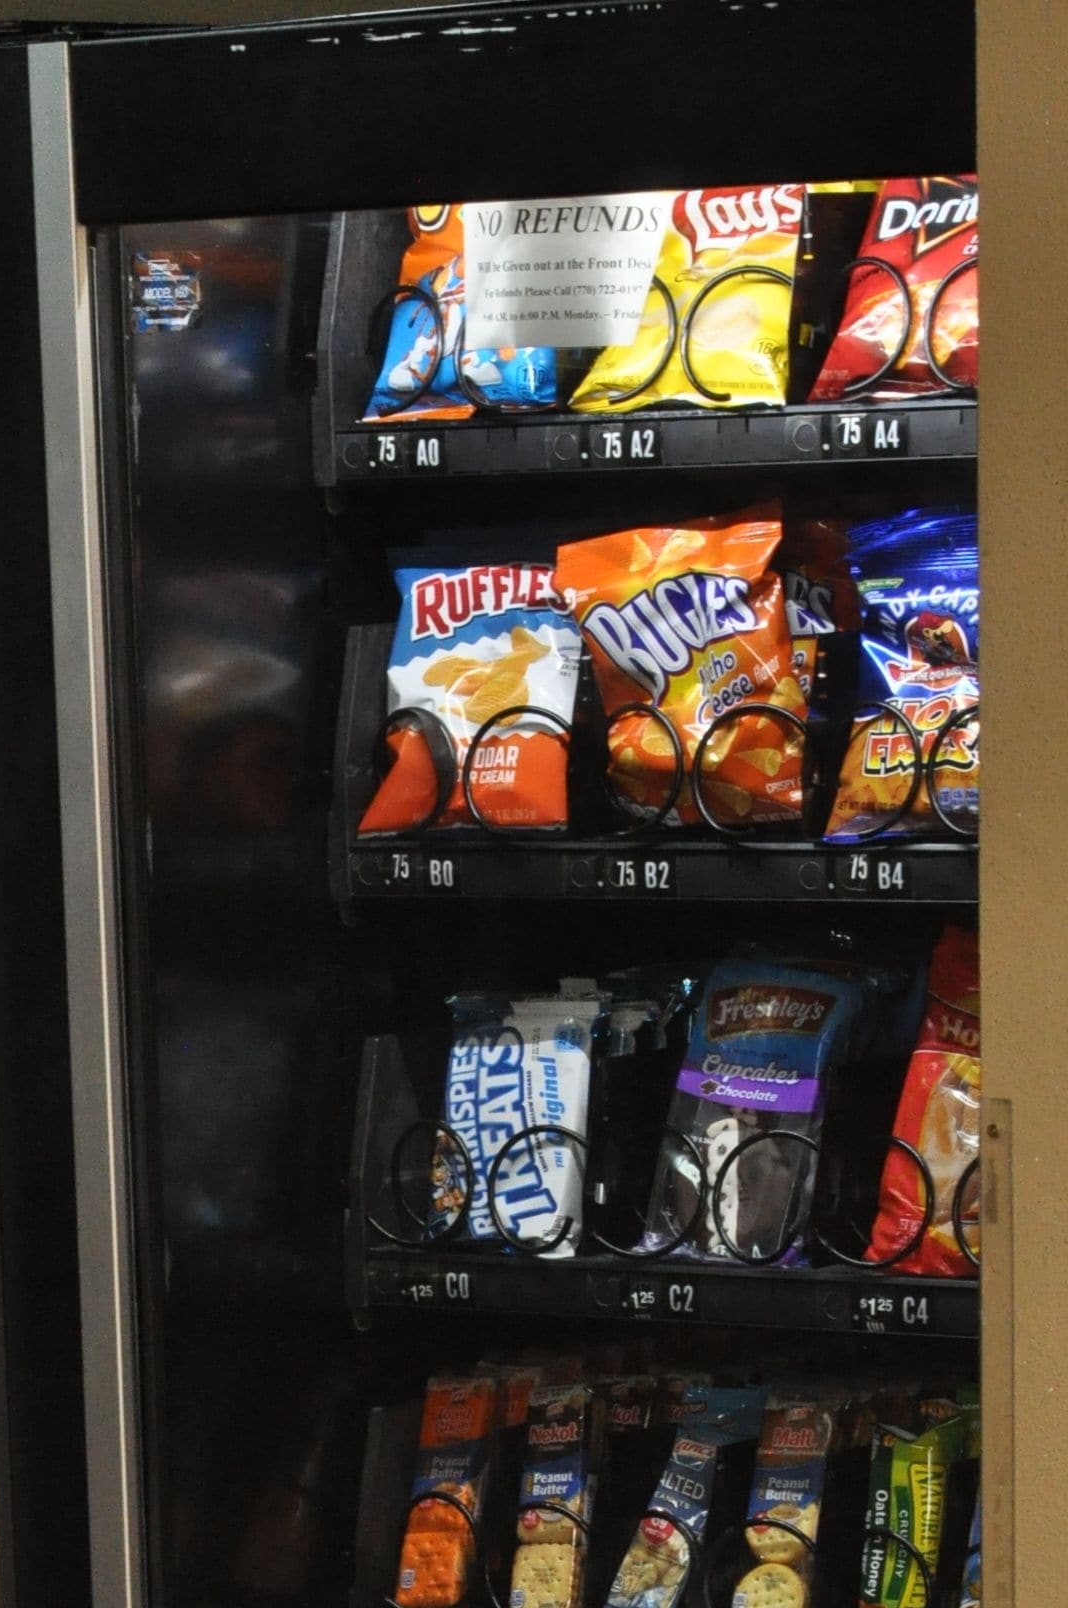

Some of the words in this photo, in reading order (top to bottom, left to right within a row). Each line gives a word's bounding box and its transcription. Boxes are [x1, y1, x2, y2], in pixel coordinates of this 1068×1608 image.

[513, 205, 662, 235] REFUNDS
[503, 259, 530, 271] Given
[534, 261, 552, 271] out
[554, 260, 565, 270] at
[567, 258, 585, 269] the
[588, 257, 623, 269] Front
[524, 287, 552, 297] Please
[553, 286, 572, 296] Call
[631, 429, 655, 458] A2
[874, 419, 900, 449] A4
[416, 438, 440, 467] A0
[410, 563, 576, 641] RUFFLES
[583, 572, 766, 703] BUGLES
[479, 770, 516, 784] CREAM
[644, 861, 670, 890] B2
[877, 861, 905, 891] B4
[715, 995, 826, 1028] Freshley's
[701, 1053, 801, 1085] Cupcakes
[536, 1056, 565, 1146] Oiginal
[715, 1082, 779, 1102] Chocolate
[478, 1030, 556, 1227] TREATS
[668, 1283, 694, 1313] C2
[902, 1295, 929, 1325] C4
[532, 1471, 574, 1484] Peanut
[532, 1484, 569, 1497] Butter
[767, 1476, 810, 1489] Peanut
[765, 1489, 805, 1501] Butter
[874, 1489, 889, 1526] Oats
[895, 1509, 909, 1579] CRUCHY
[864, 1548, 885, 1598] Honey
